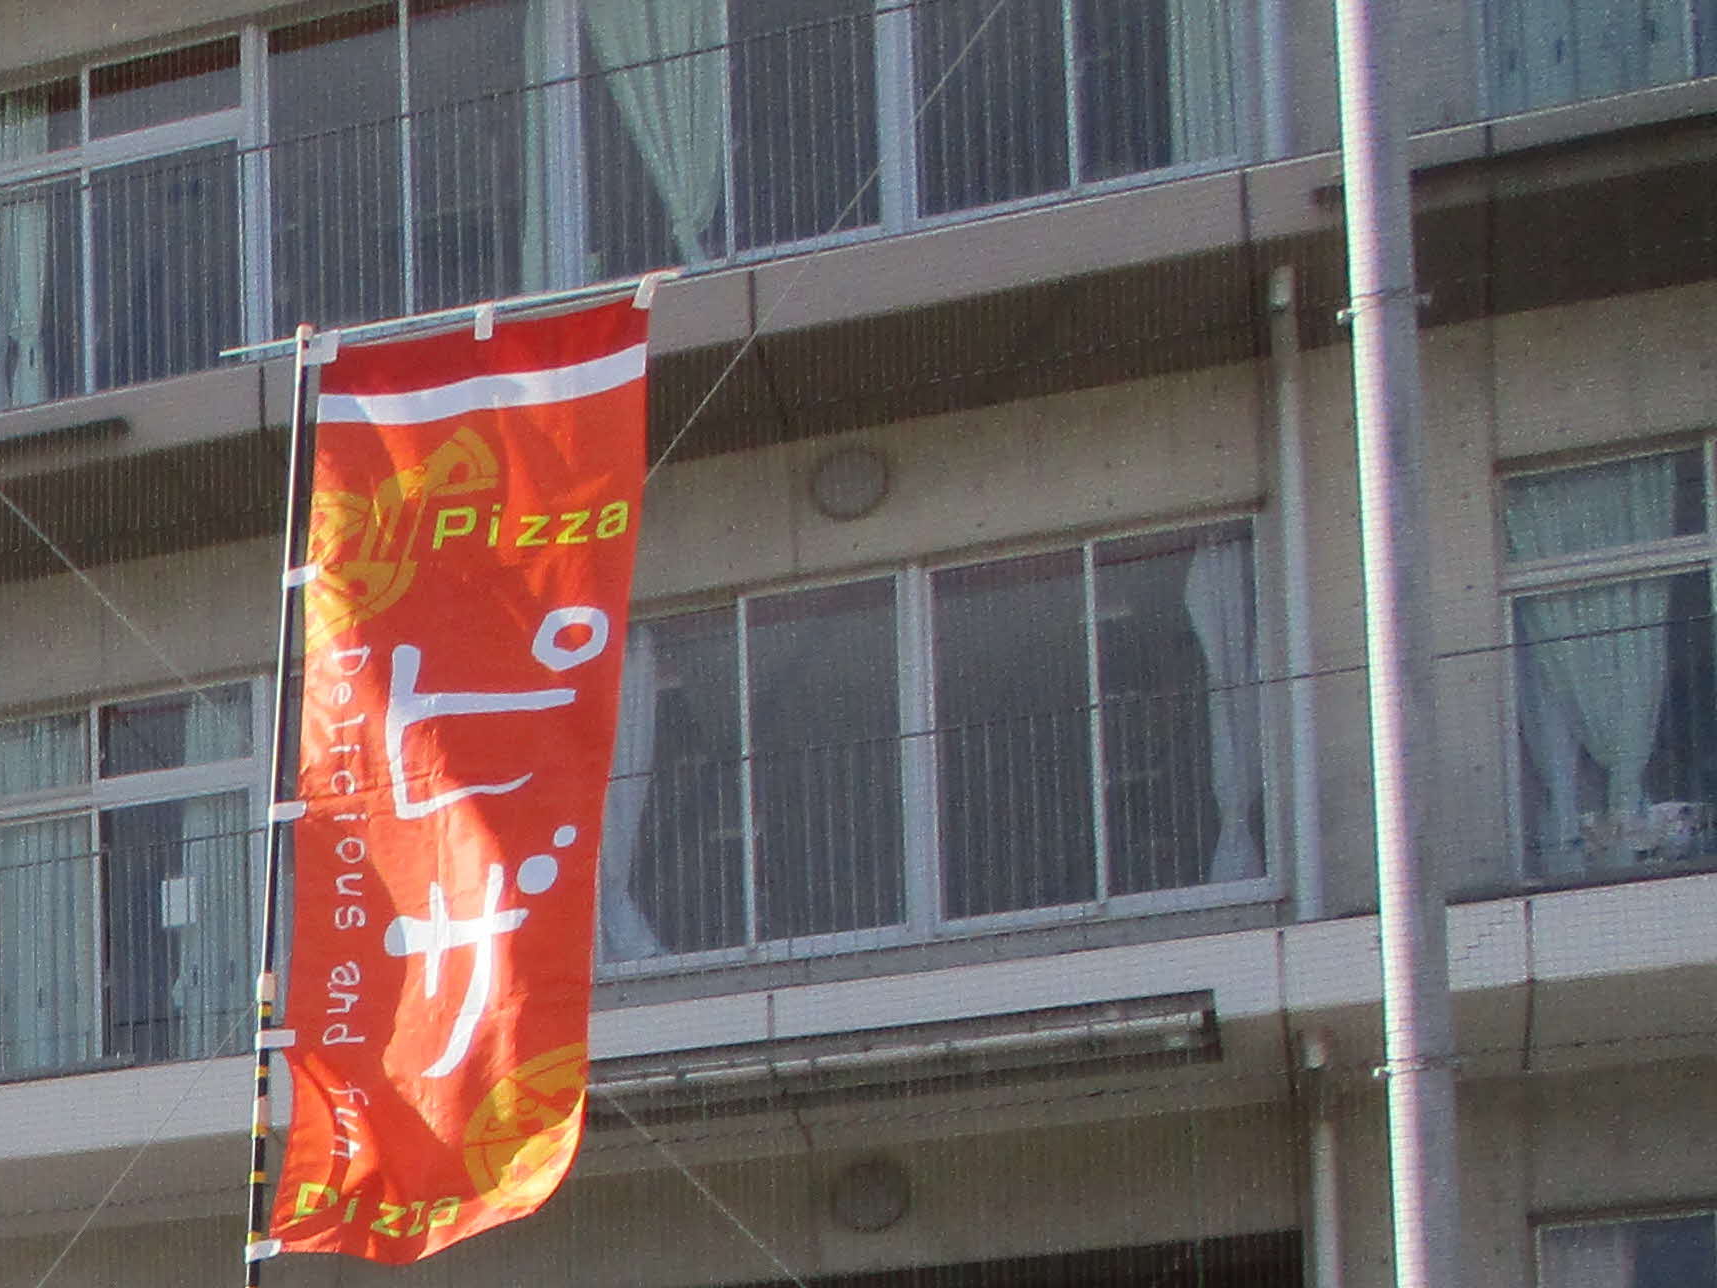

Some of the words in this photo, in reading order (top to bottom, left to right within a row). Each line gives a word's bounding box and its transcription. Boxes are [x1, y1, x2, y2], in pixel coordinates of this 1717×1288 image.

[433, 500, 629, 549] Pizza
[328, 645, 371, 930] Delicious
[383, 605, 609, 1078] ピザ
[322, 960, 366, 1046] and
